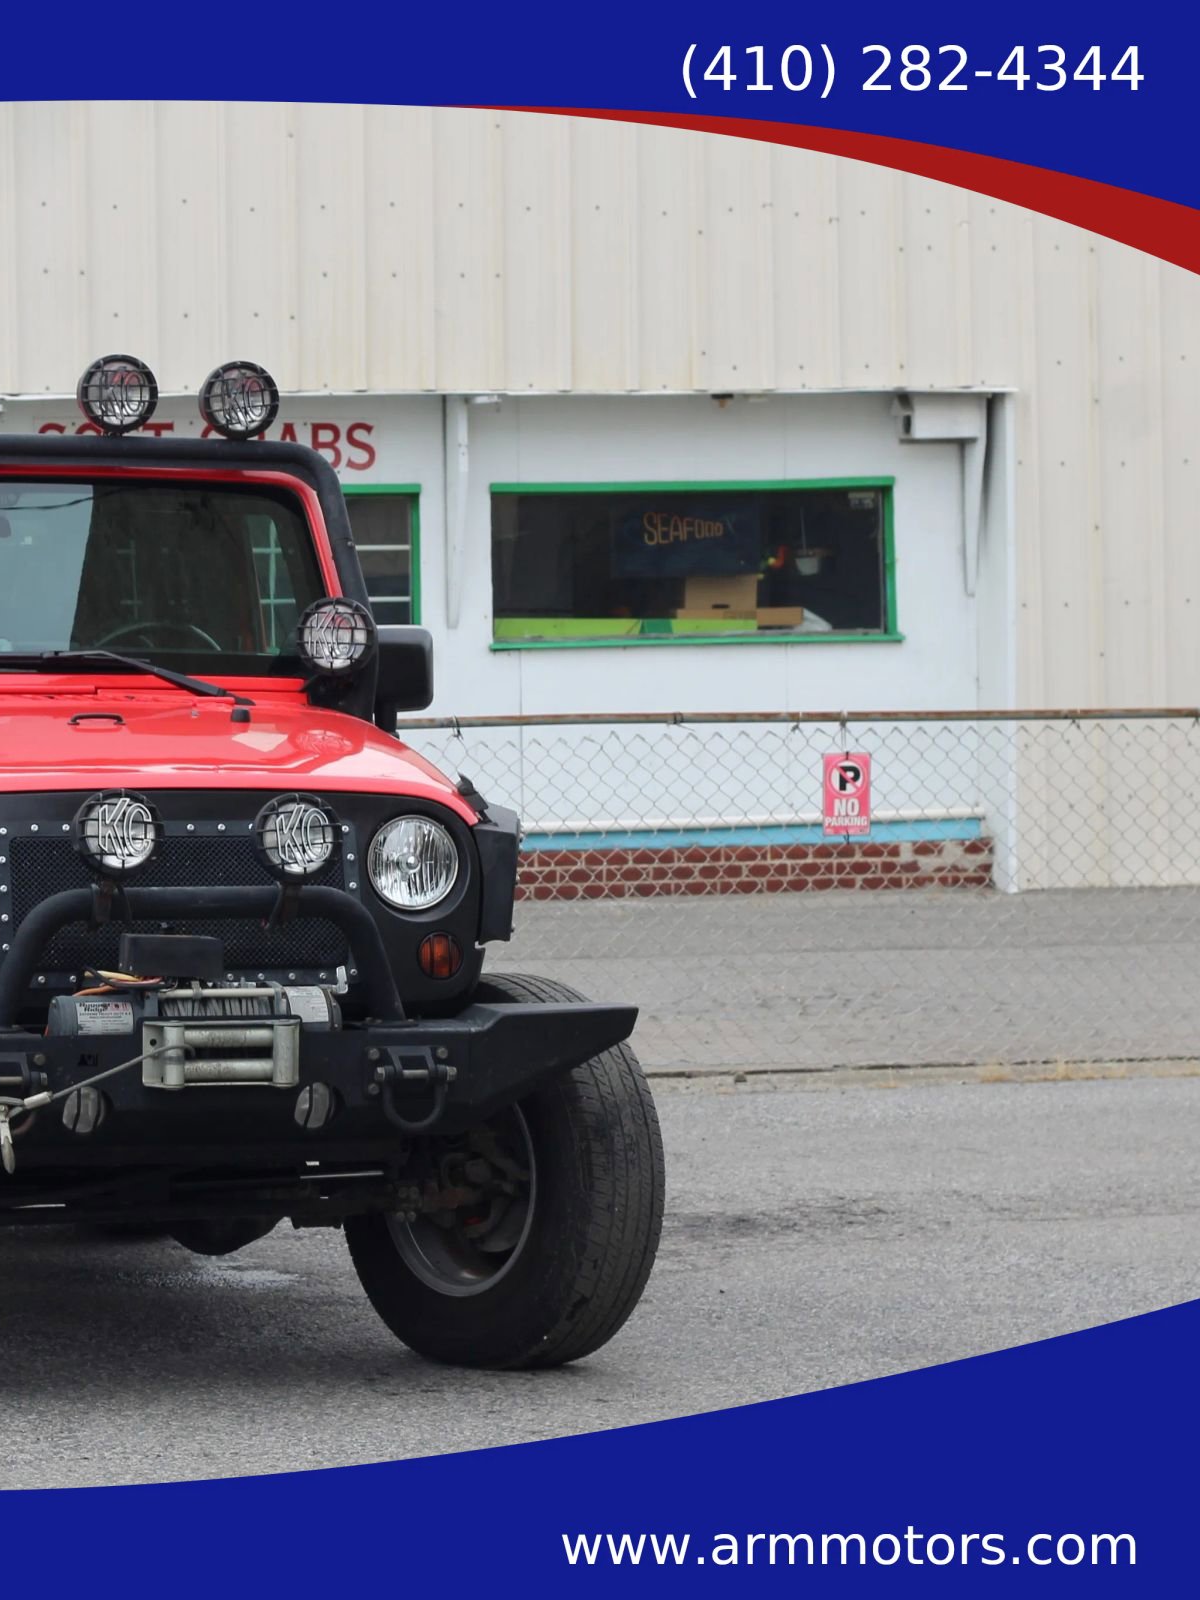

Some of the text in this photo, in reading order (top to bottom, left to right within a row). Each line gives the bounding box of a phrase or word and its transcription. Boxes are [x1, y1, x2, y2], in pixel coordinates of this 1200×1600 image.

[825, 816, 868, 827] PARKING
[833, 798, 860, 816] NO
[98, 797, 152, 860] KC
[275, 804, 330, 868] KC
